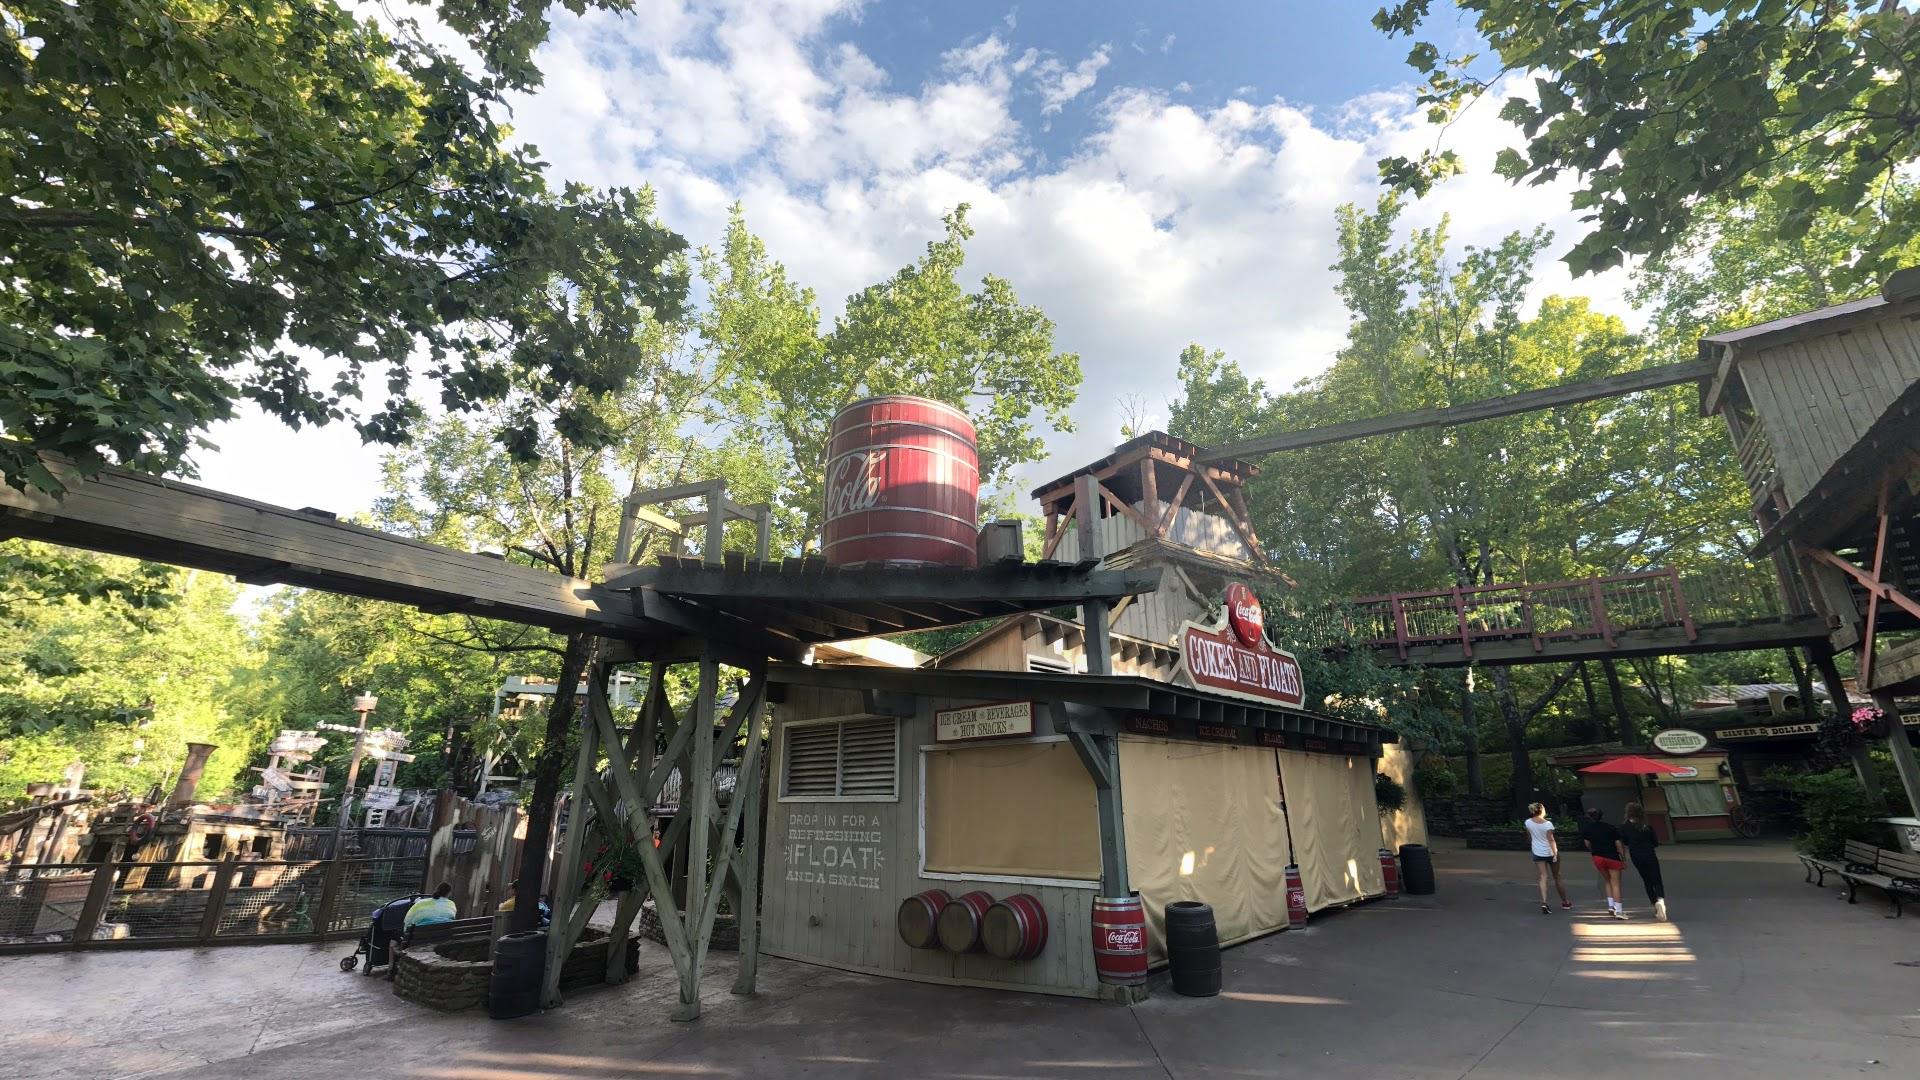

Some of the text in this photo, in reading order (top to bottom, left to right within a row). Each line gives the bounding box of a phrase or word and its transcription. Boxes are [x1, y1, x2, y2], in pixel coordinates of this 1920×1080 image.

[826, 450, 887, 518] Cola
[1239, 653, 1258, 682] AND
[1257, 653, 1300, 697] FLOATS
[940, 704, 1029, 726] ICE CREAM BEVERAGES
[960, 721, 1008, 737] HOT SNACKS
[1135, 718, 1169, 732] NACHOS
[1722, 729, 1757, 737] SILVER
[1772, 725, 1814, 735] DOLLAR
[789, 814, 880, 827] DROP IN FOR A
[788, 829, 881, 843] REFRESHING
[794, 844, 873, 870] FLOAT
[786, 871, 880, 889] AND A SNACK
[1108, 931, 1140, 944] Coca-Cola
